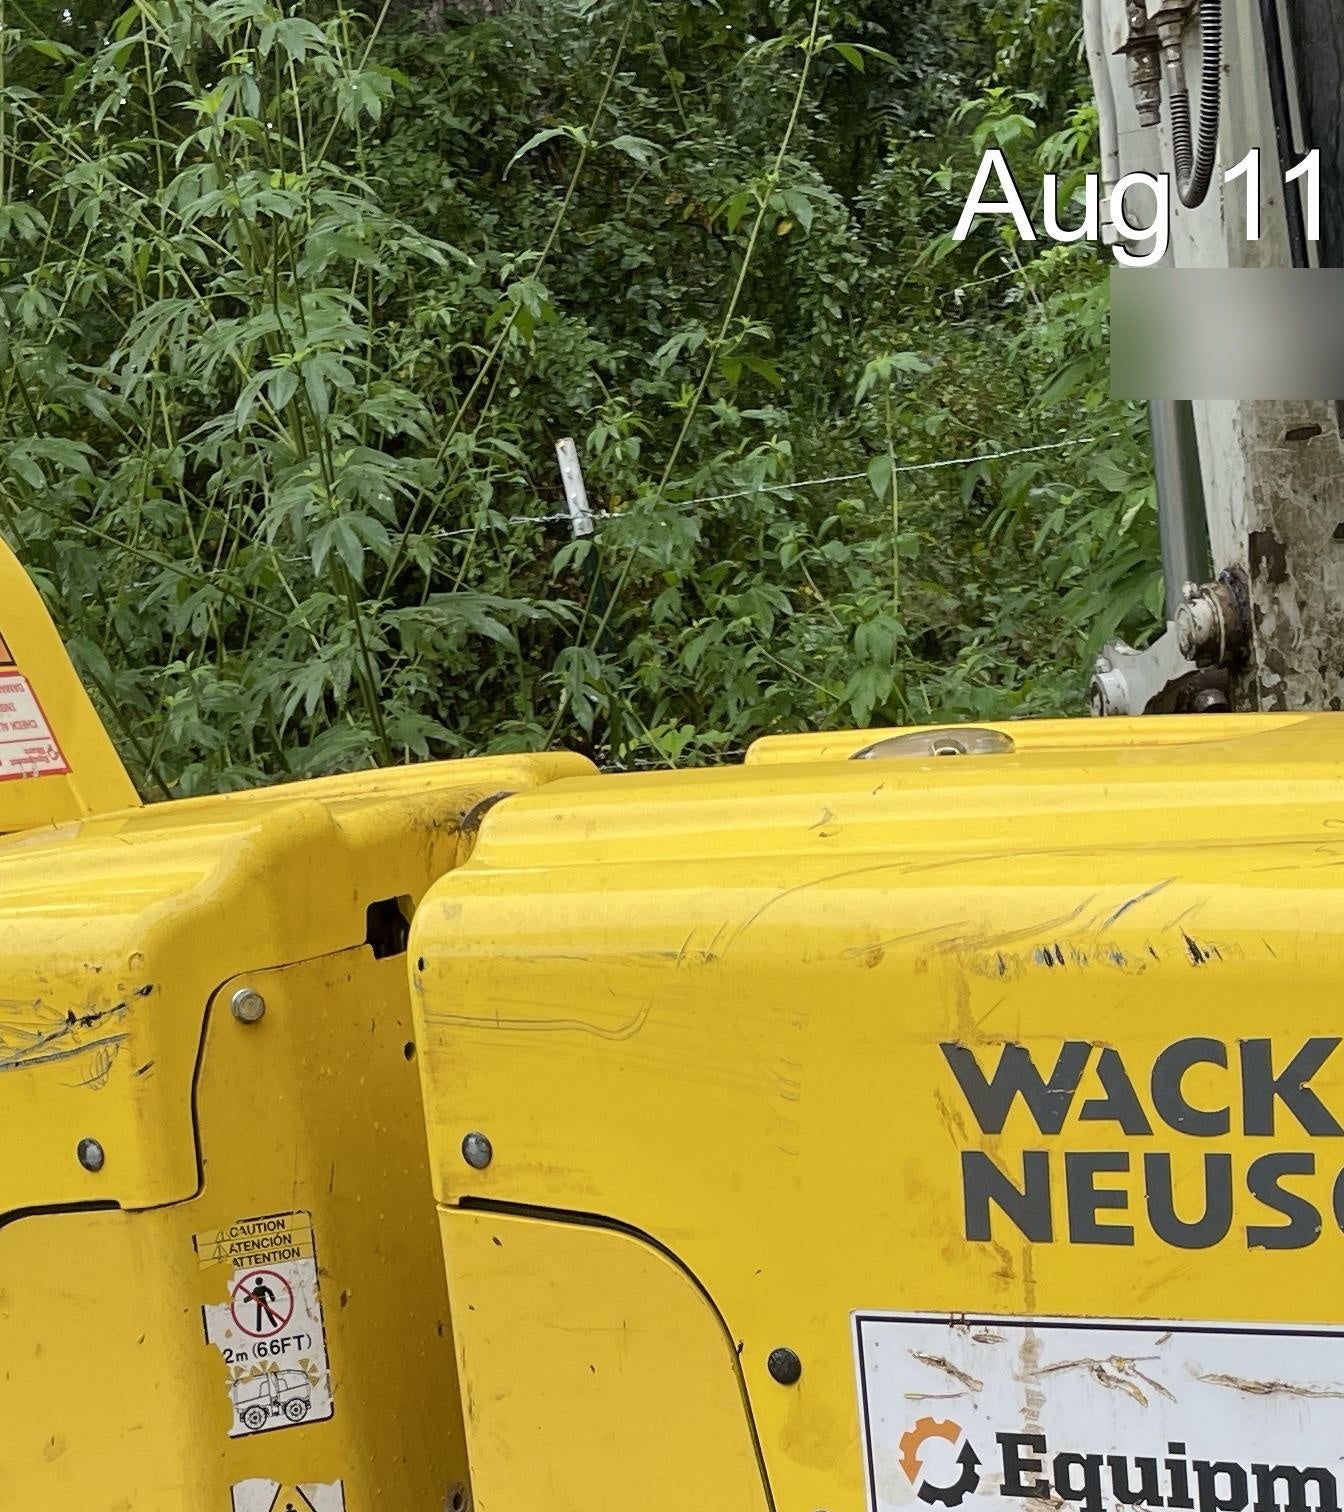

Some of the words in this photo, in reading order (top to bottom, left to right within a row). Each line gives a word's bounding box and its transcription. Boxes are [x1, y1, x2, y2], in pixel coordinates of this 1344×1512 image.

[11, 720, 37, 730] CHECK
[230, 1219, 285, 1237] CAUTION
[229, 1232, 292, 1253] ATENCIÓN
[233, 1247, 301, 1267] ATTENTION
